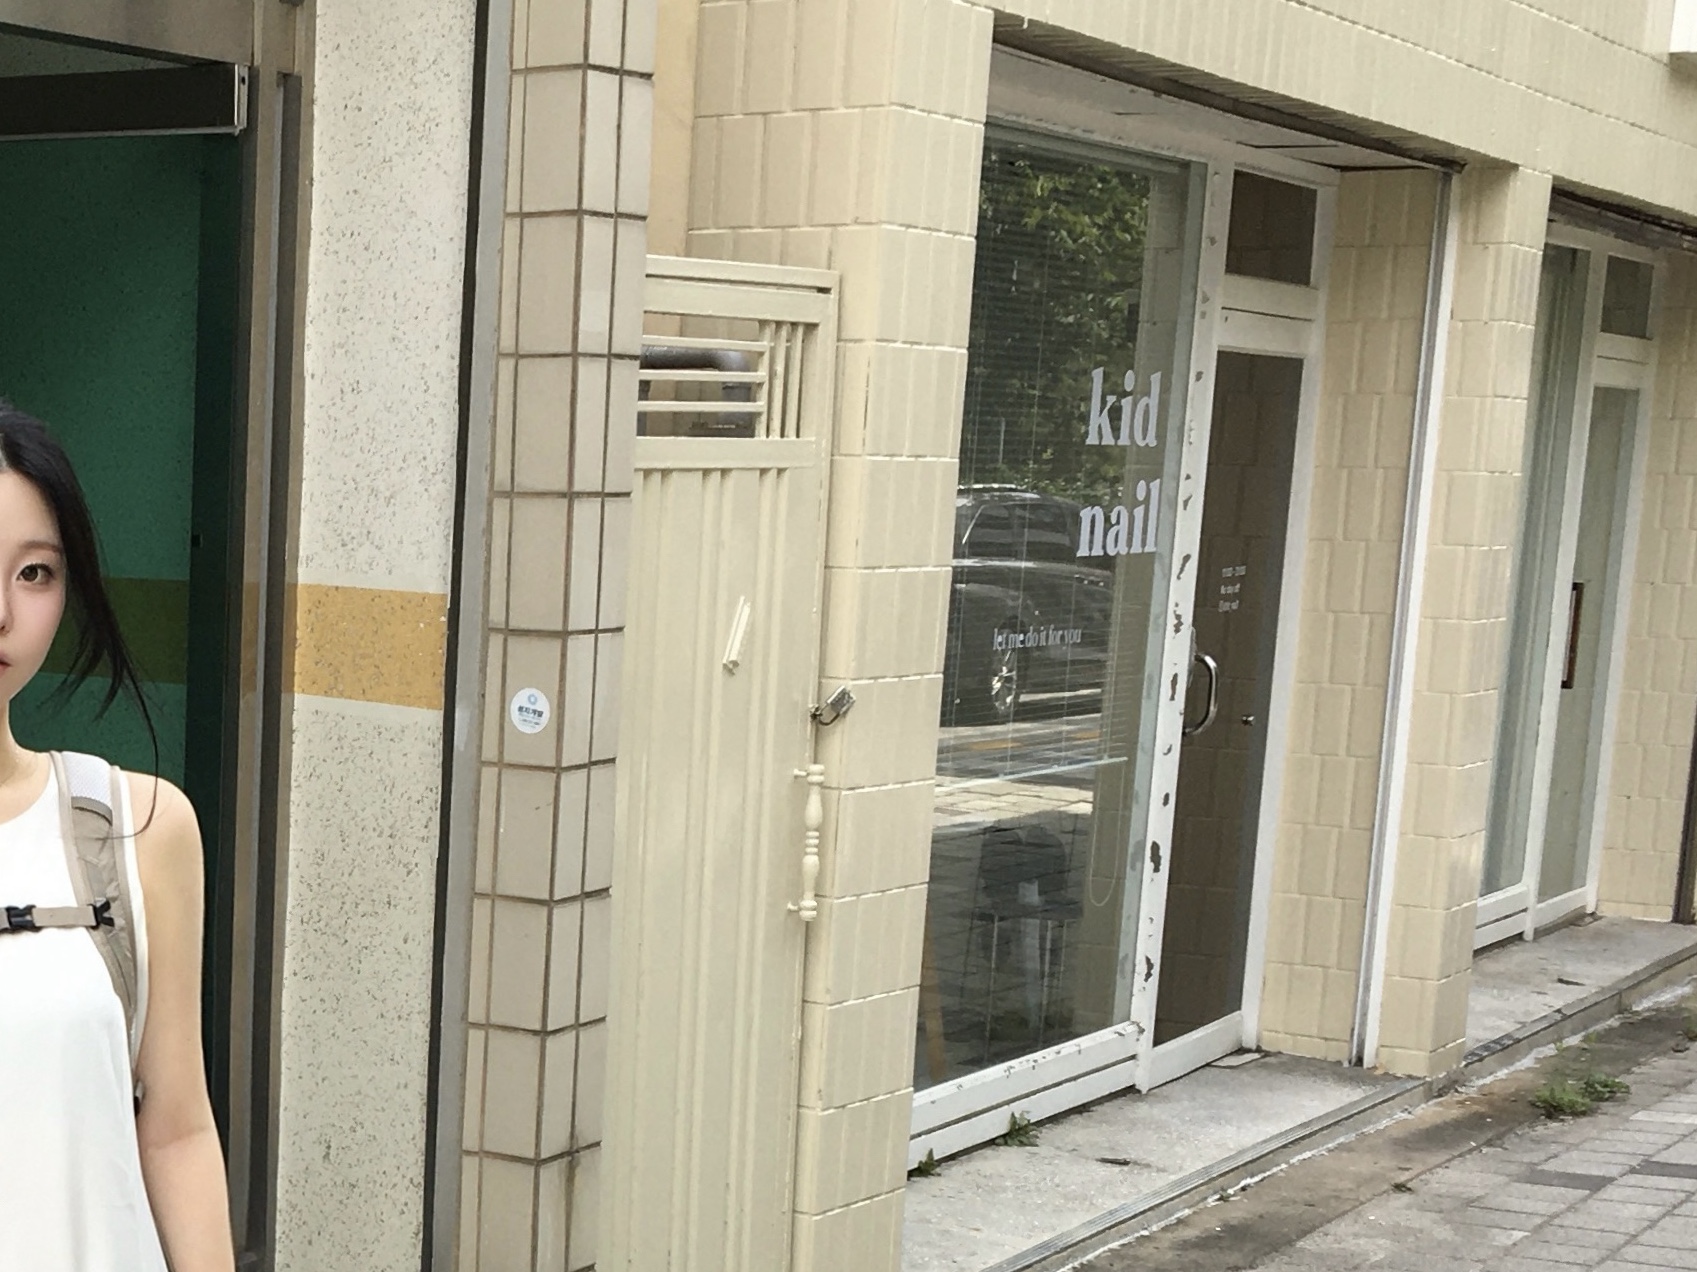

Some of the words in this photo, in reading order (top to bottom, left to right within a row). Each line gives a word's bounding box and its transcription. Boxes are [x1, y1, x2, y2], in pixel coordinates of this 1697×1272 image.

[1085, 366, 1162, 447] kid
[1076, 478, 1161, 557] nail
[992, 627, 1007, 651] let
[1008, 632, 1025, 649] me
[1025, 625, 1039, 648] do
[1039, 625, 1047, 647] it
[1048, 624, 1063, 646] for
[1063, 628, 1082, 650] you
